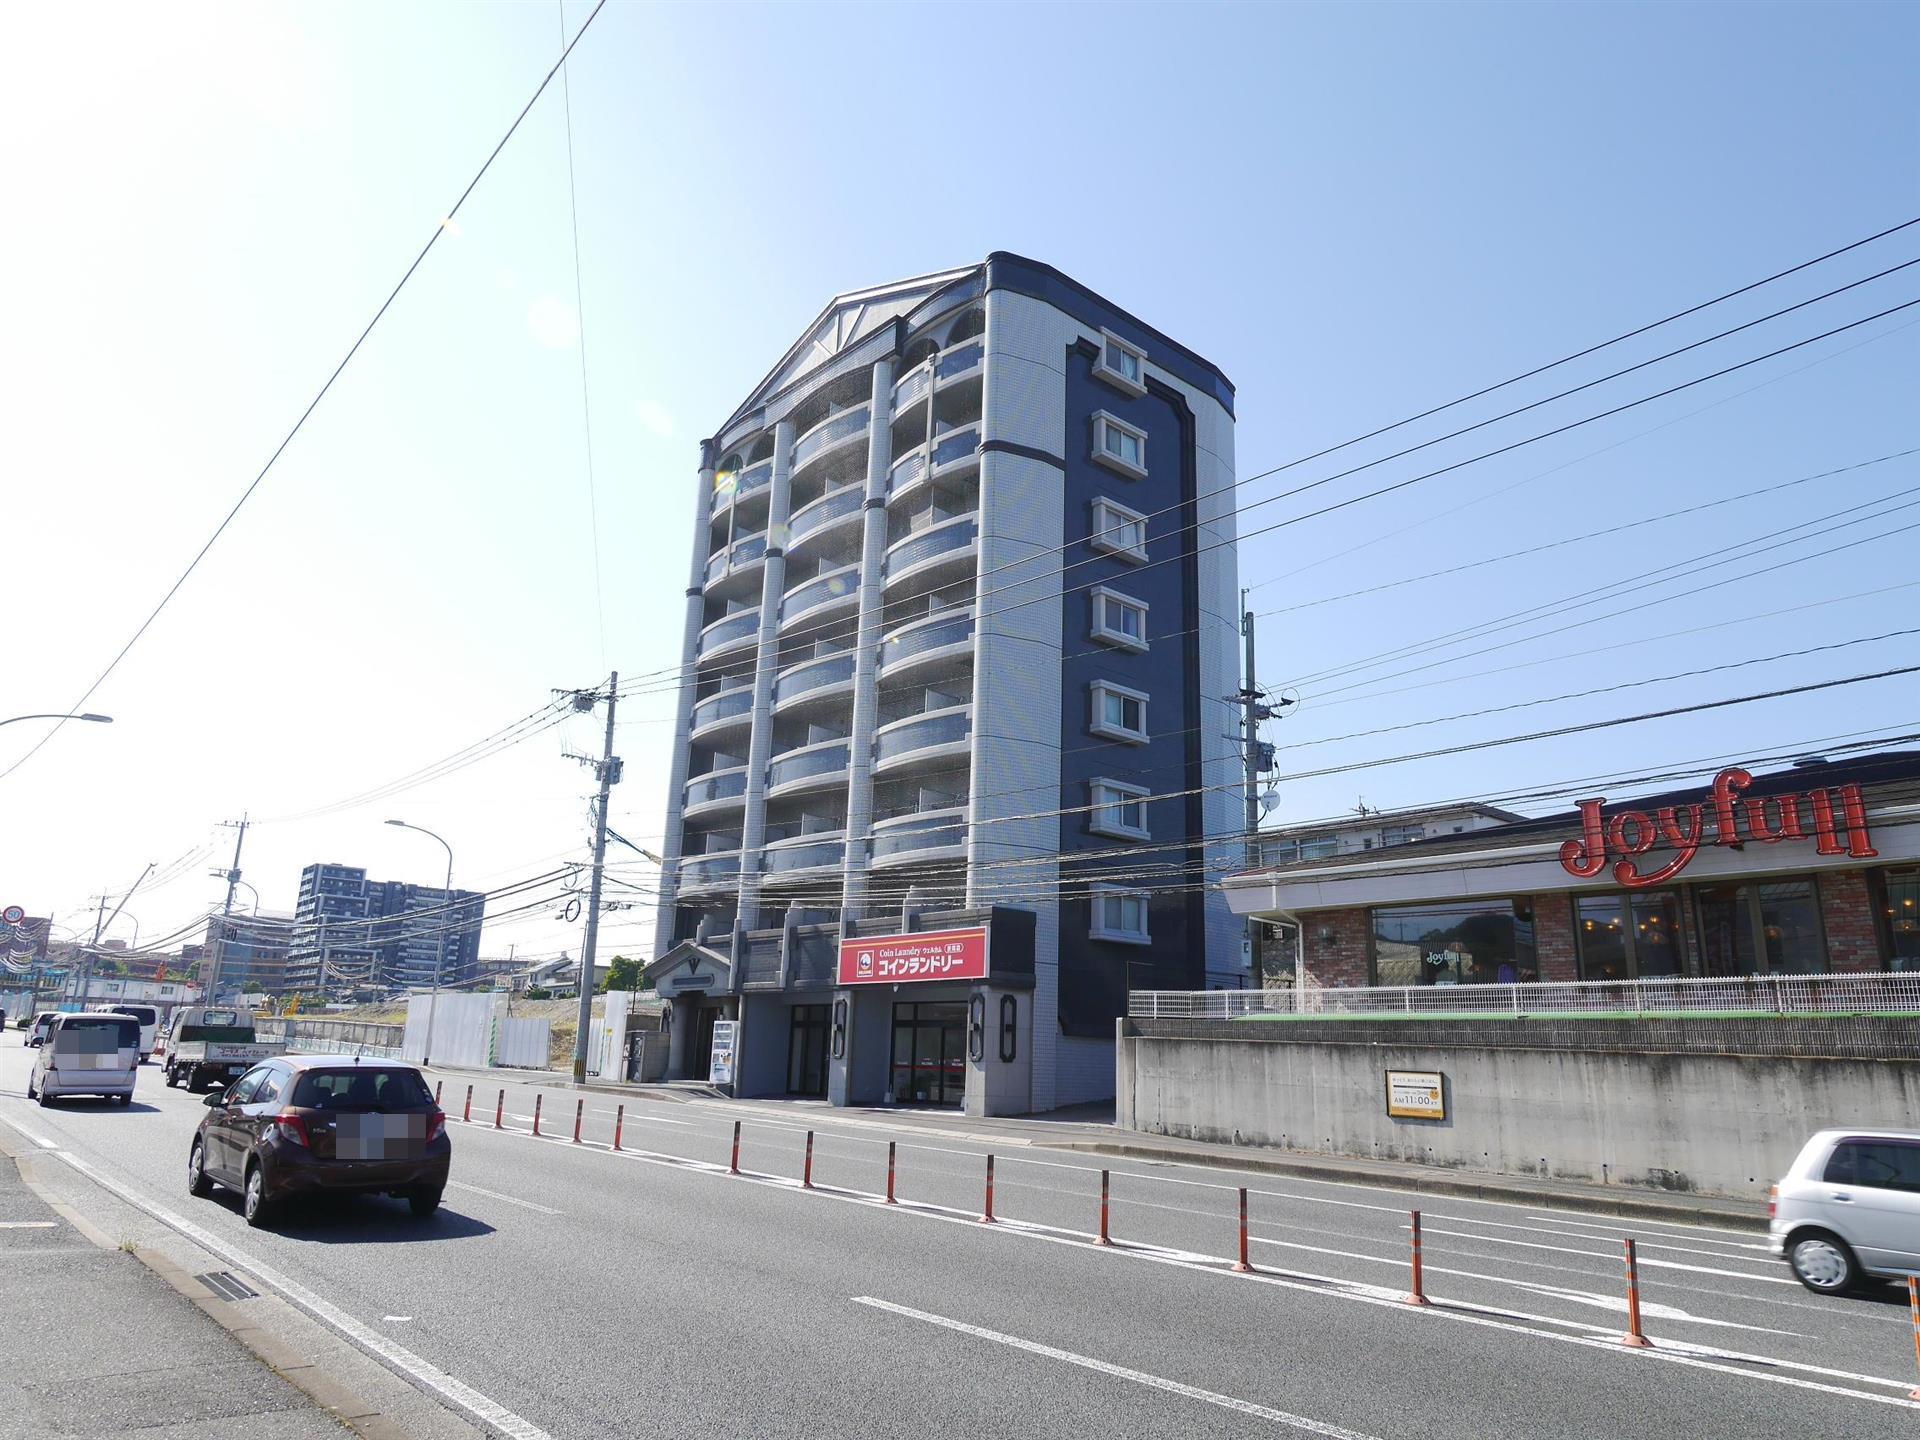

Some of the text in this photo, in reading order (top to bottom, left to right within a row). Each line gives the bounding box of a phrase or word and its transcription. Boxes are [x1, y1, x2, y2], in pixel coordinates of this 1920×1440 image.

[1559, 767, 1878, 888] Joyfull
[880, 947, 920, 957] Coin Laundry
[879, 955, 963, 976] コインランドリー
